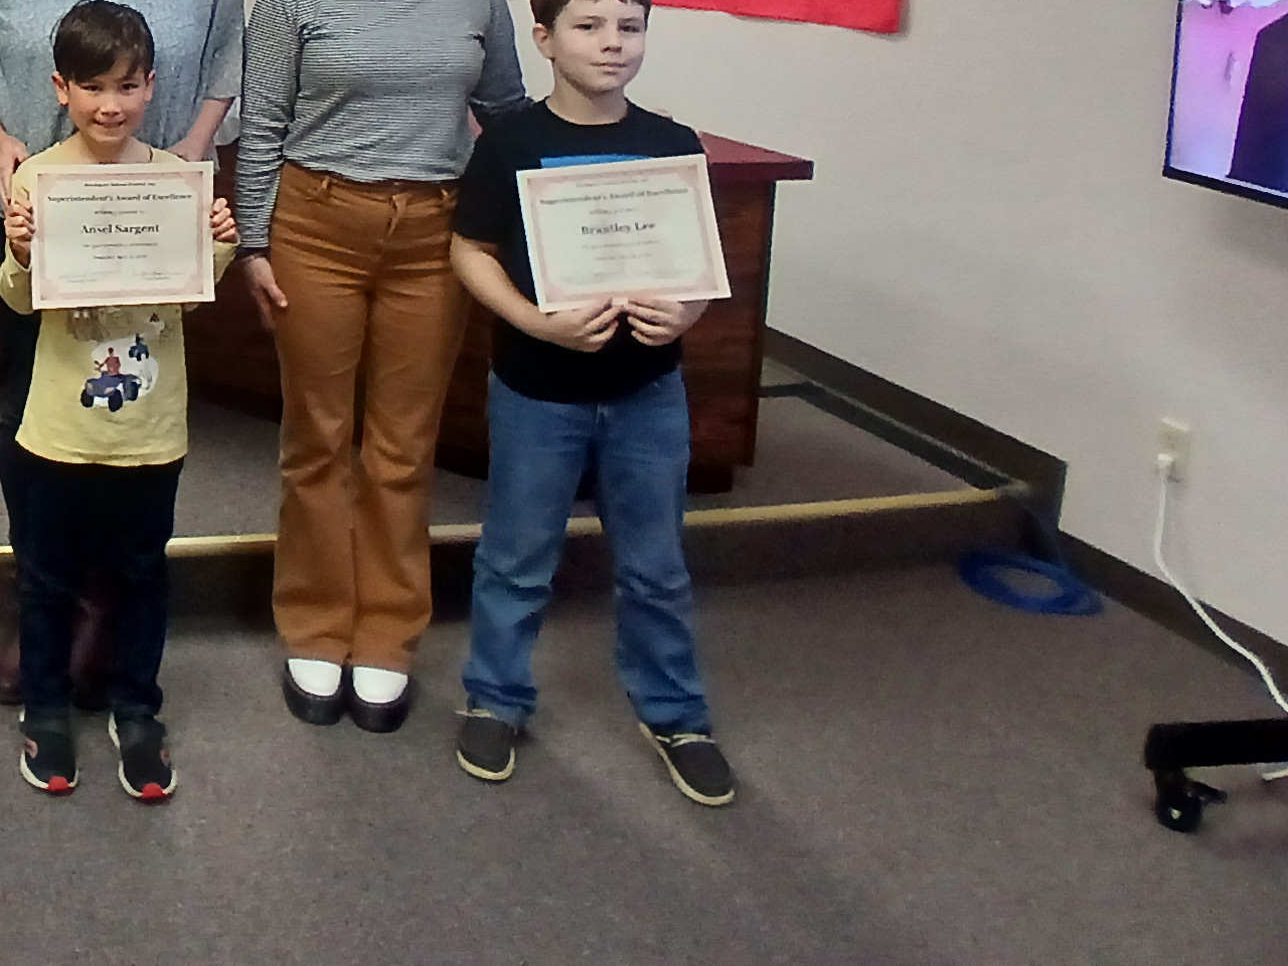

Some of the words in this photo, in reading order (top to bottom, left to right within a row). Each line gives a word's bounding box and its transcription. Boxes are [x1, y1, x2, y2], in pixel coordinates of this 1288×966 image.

[152, 193, 192, 201] Excellence
[81, 224, 112, 234] Ansel
[115, 224, 159, 235] Sargent
[634, 221, 655, 231] Lee
